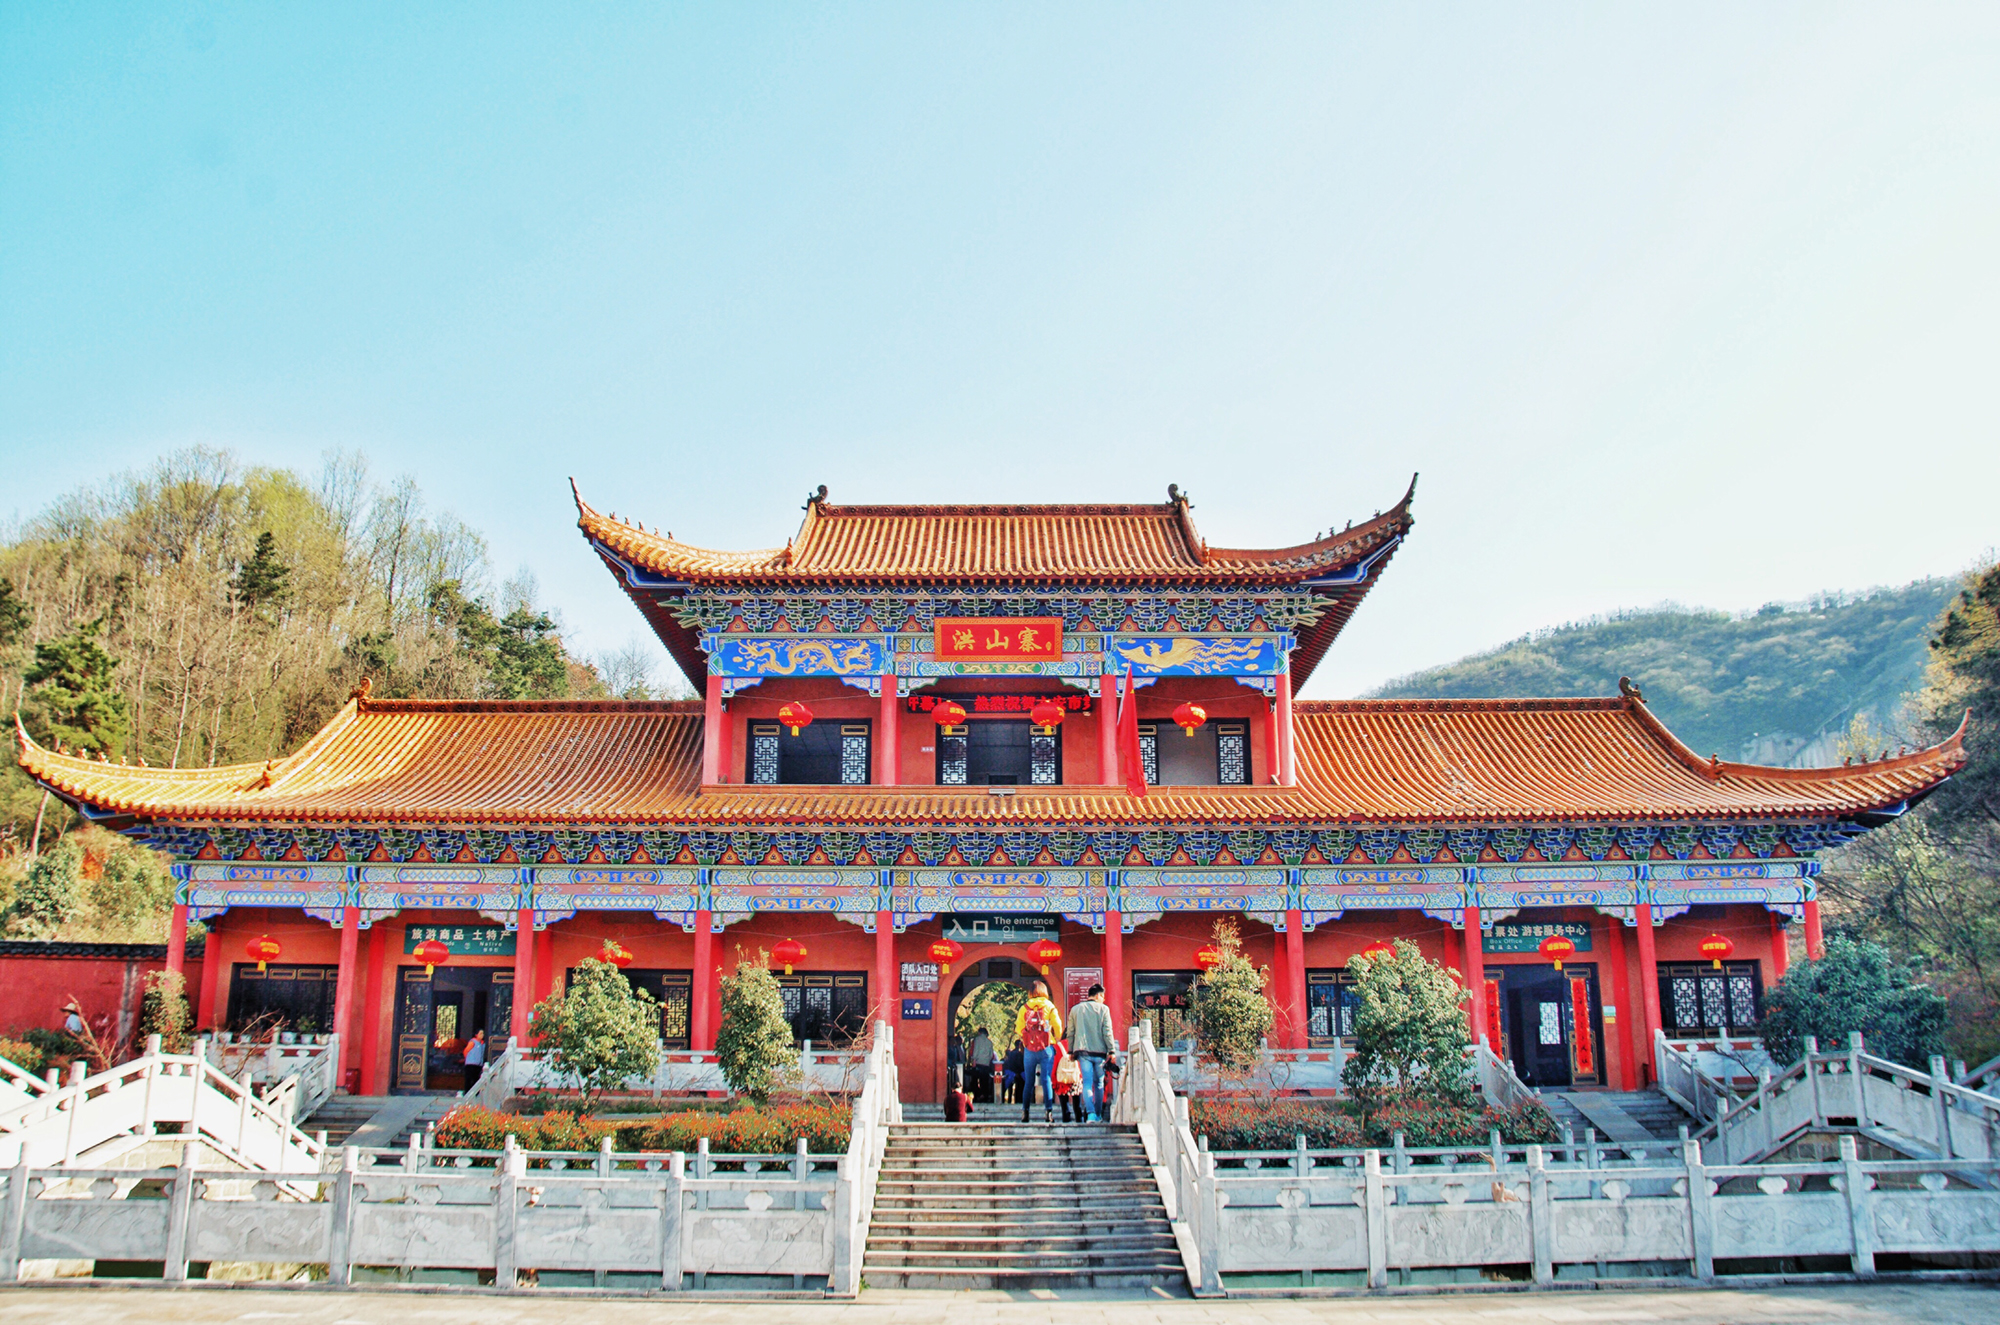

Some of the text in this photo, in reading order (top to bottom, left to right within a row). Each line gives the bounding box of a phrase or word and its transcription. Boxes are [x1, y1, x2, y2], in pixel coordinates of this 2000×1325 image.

[952, 626, 1042, 653] 洪山寨
[993, 916, 1055, 925] The entrance
[947, 918, 989, 937] 入口
[1521, 924, 1587, 937] 游客服务中心
[411, 928, 511, 941] 旅游商品 土特产
[901, 963, 938, 975] 团队入口处
[1144, 993, 1187, 1006] 售票处
